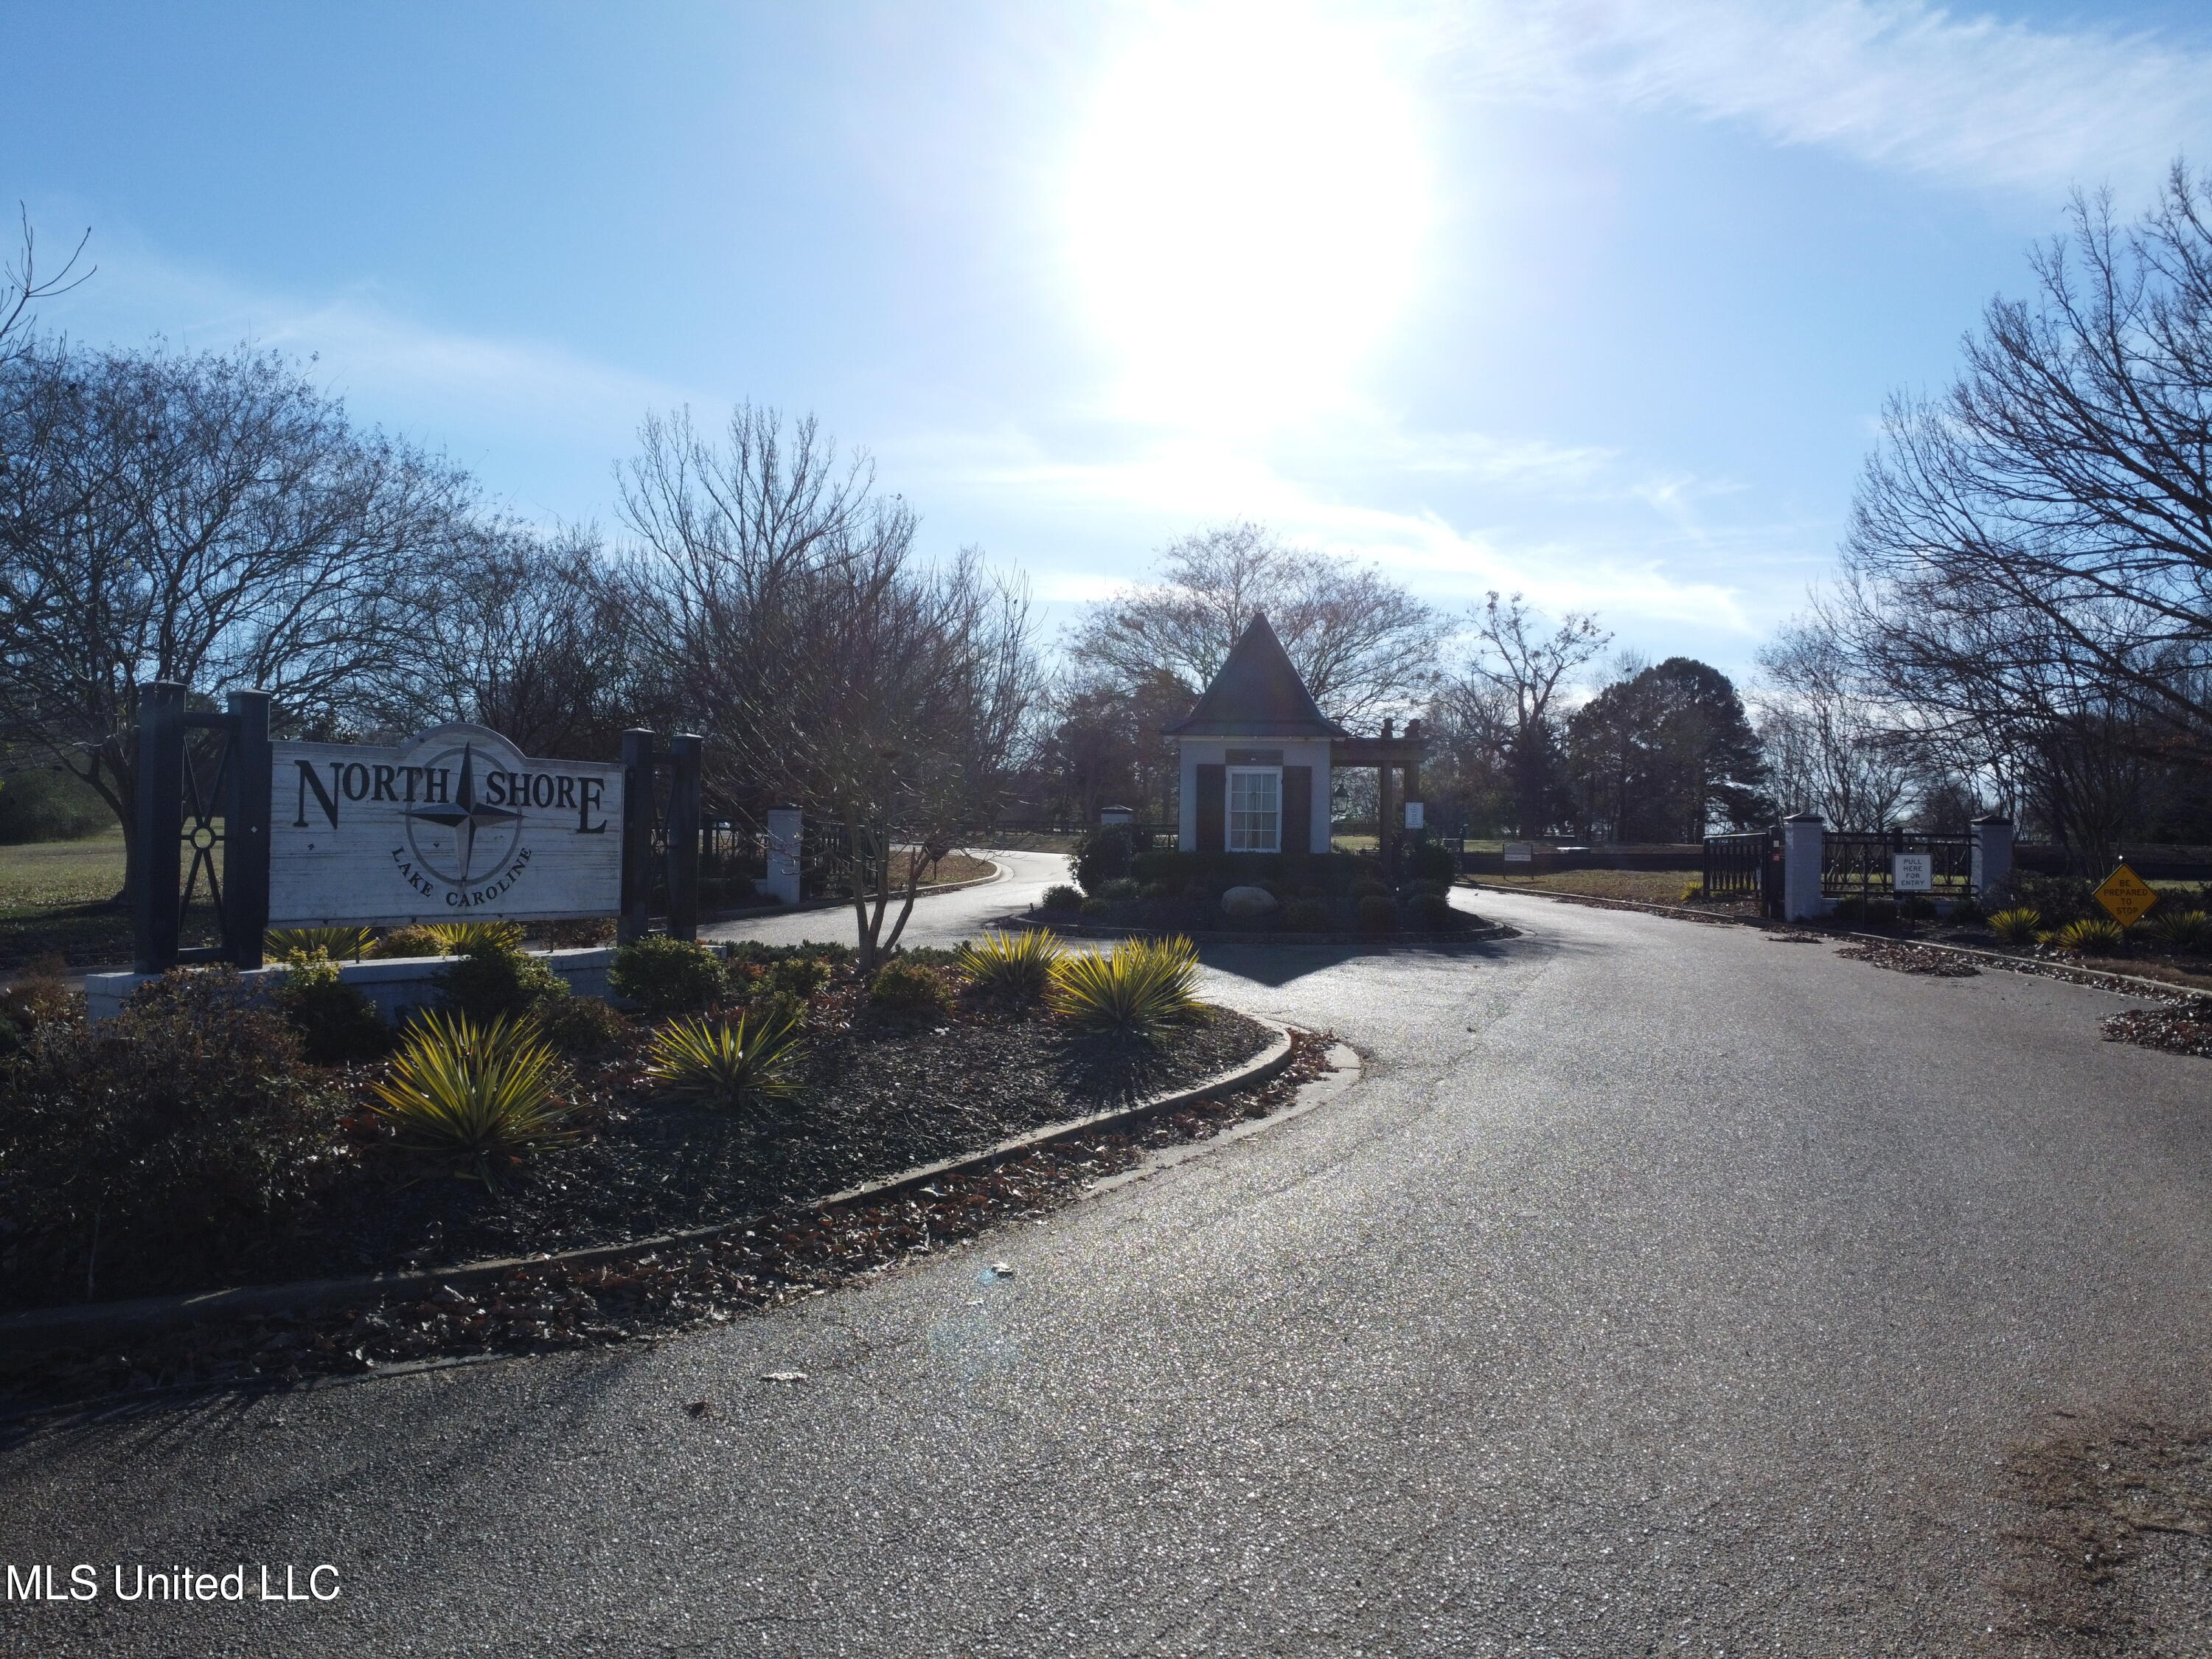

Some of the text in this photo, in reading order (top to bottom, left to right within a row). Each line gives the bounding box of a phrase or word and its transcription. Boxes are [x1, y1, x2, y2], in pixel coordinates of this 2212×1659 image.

[293, 759, 608, 833] NORTH SHORE
[391, 846, 532, 907] LAKE CAROLINE
